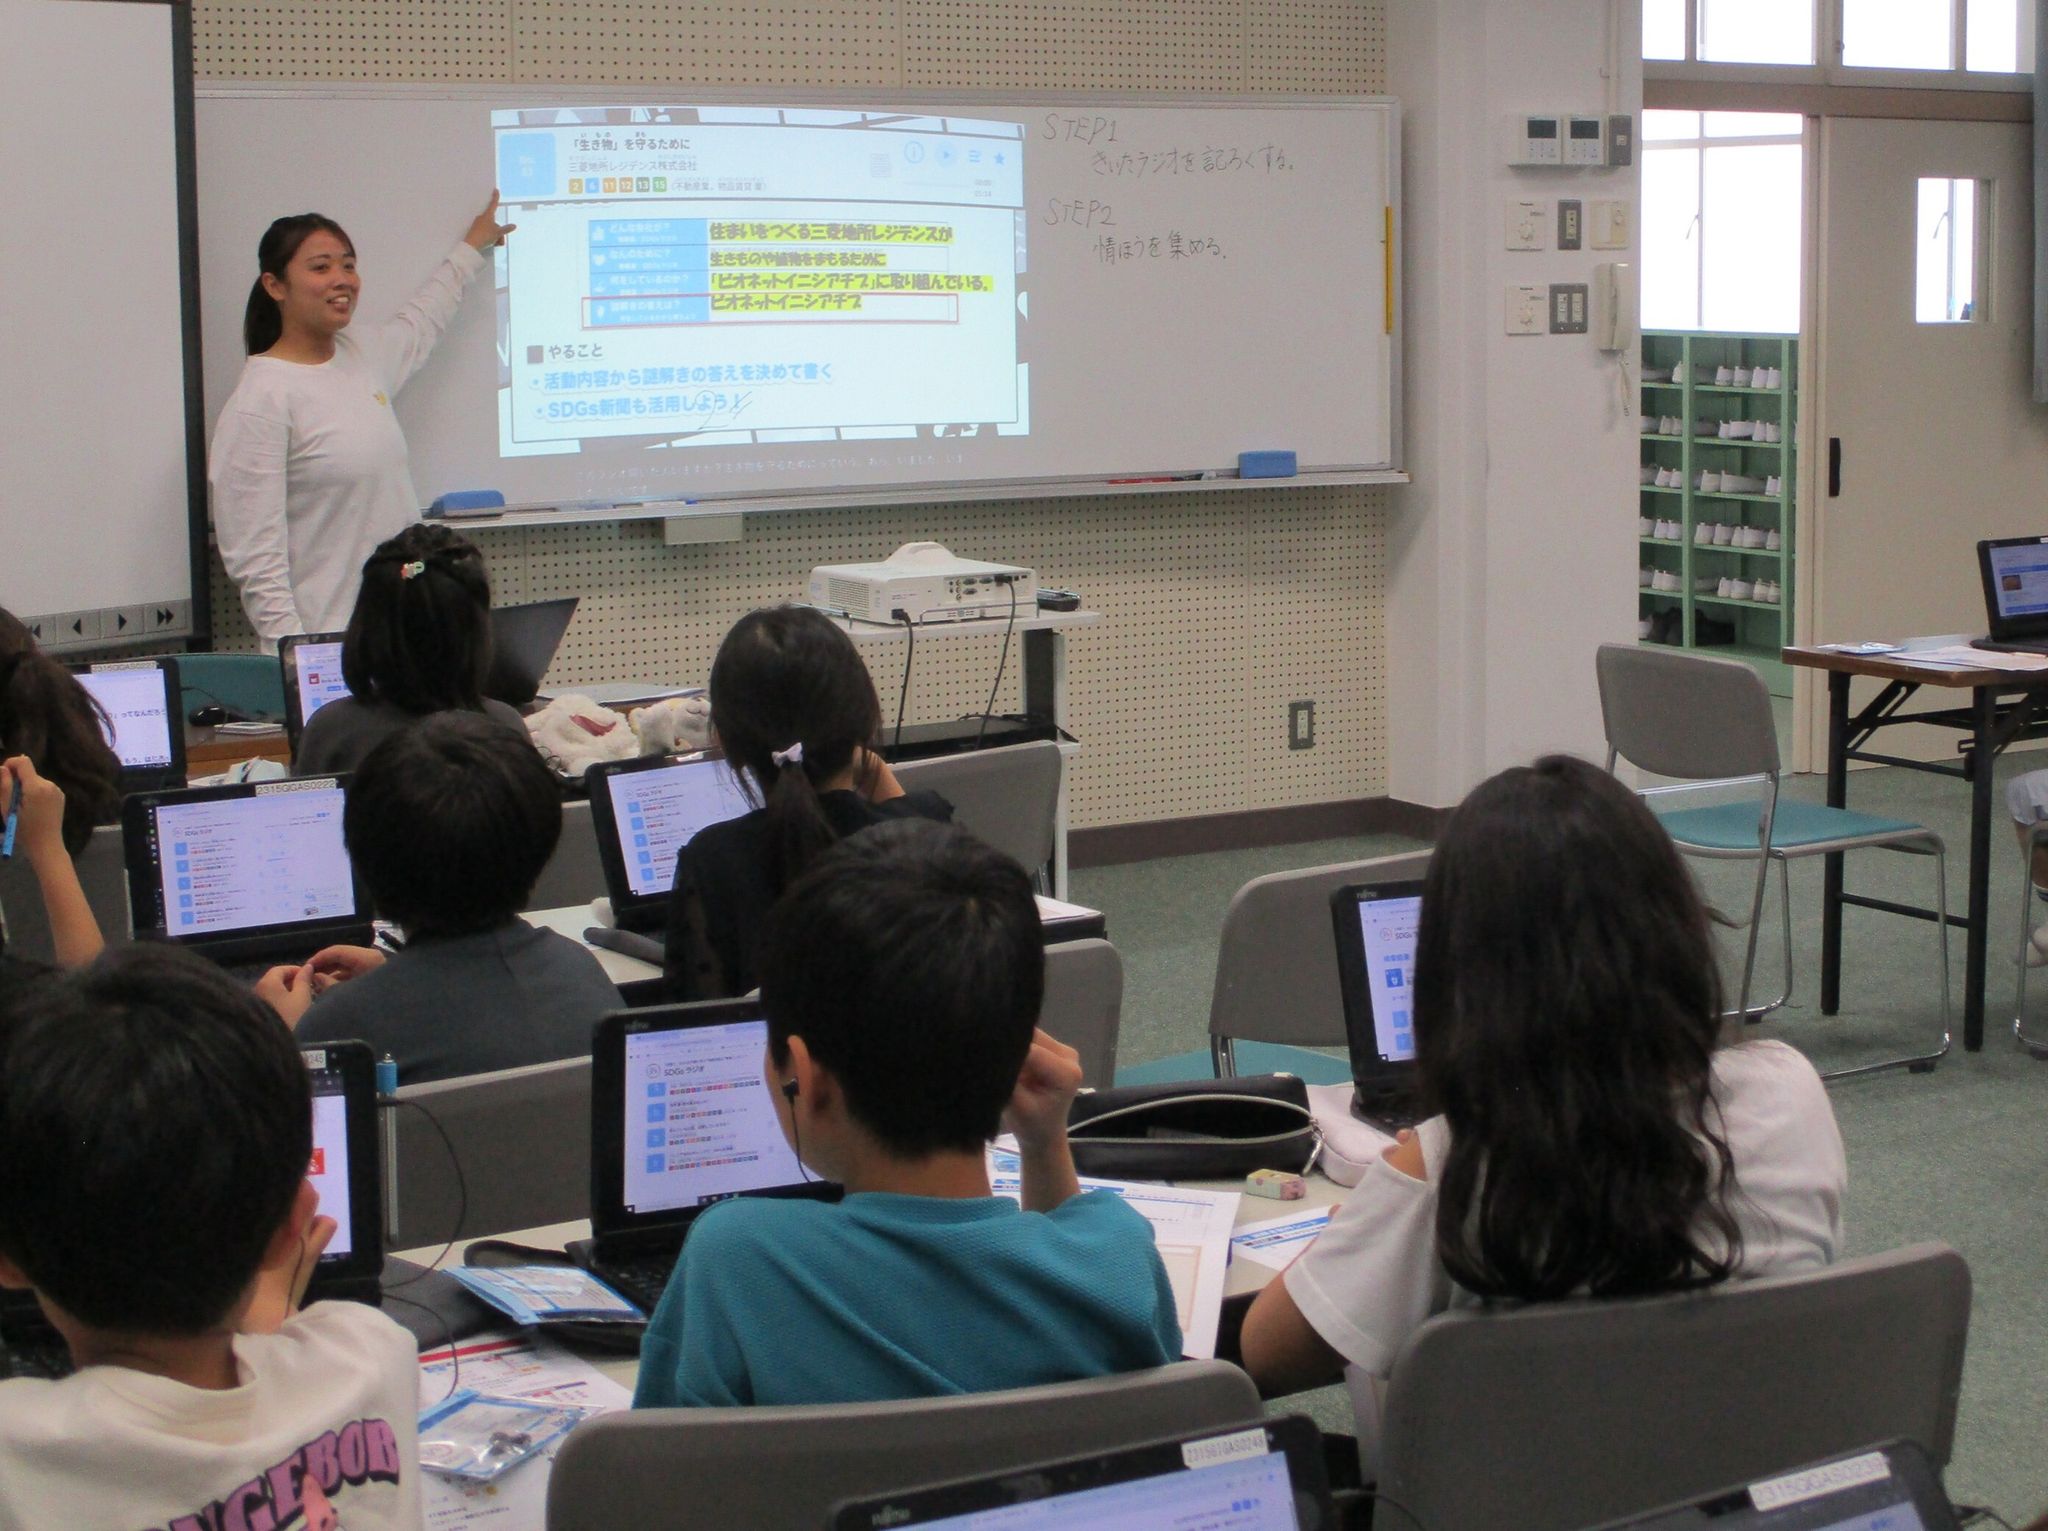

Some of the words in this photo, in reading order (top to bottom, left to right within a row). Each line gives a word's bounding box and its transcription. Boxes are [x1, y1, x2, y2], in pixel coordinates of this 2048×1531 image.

[1042, 113, 1119, 145] STEP1
[568, 160, 697, 173] 三菱地所レジデンス株式会社
[1043, 198, 1117, 229] STEP2
[709, 222, 953, 243] 住まいをつくる三菱地所レジデンスが
[709, 250, 888, 267] 生きものや植物をまもるために
[548, 343, 603, 359] やること
[544, 362, 833, 391] 活動内容から謎解きの答えを決めて書く
